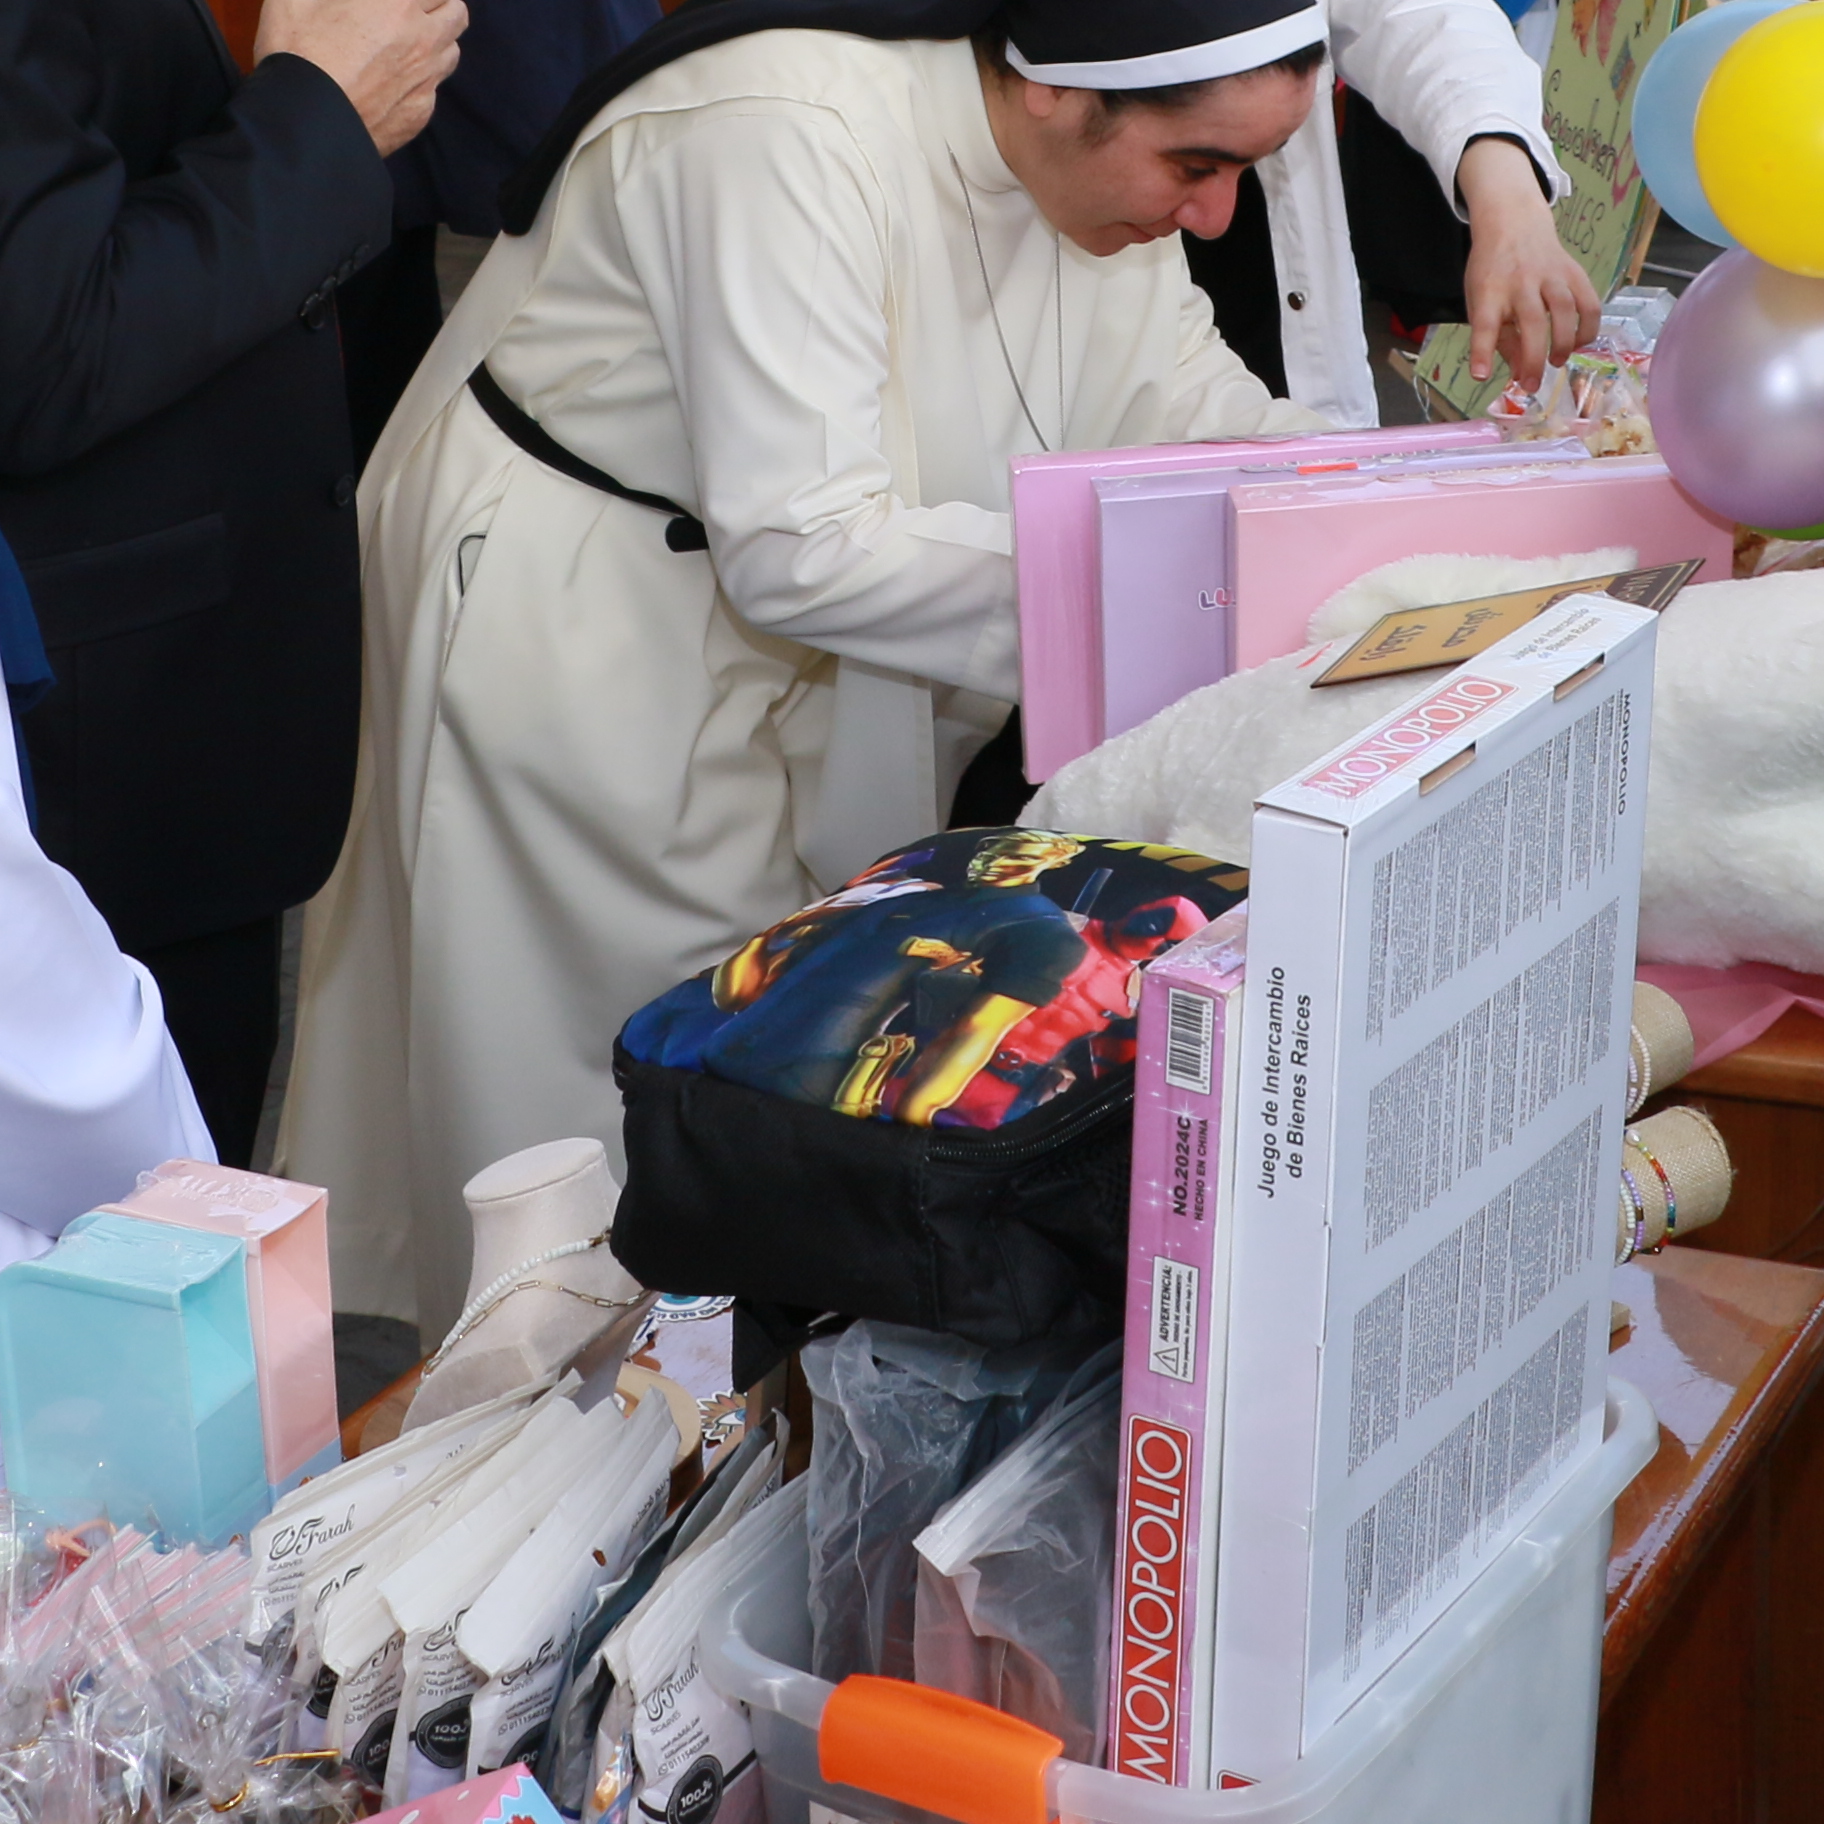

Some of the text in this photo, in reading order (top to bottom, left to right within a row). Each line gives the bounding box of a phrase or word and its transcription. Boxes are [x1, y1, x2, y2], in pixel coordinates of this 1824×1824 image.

[1198, 587, 1236, 610] LU
[1314, 679, 1504, 797] MONOPOLIO
[1617, 692, 1632, 816] MONOPOLIO
[1257, 966, 1285, 1199] Juego de Intercambio
[1286, 994, 1312, 1179] de Bienes Raices
[1172, 1115, 1192, 1217] NO.2024C
[1194, 1118, 1209, 1221] HECHO EN CHINA
[1159, 1264, 1173, 1342] ADVERTENCIA:
[294, 1503, 356, 1556] Farah
[422, 1651, 459, 1663] SCARV
[1122, 1429, 1183, 1784] MONOPOLIO
[650, 1710, 681, 1736] SCARVES
